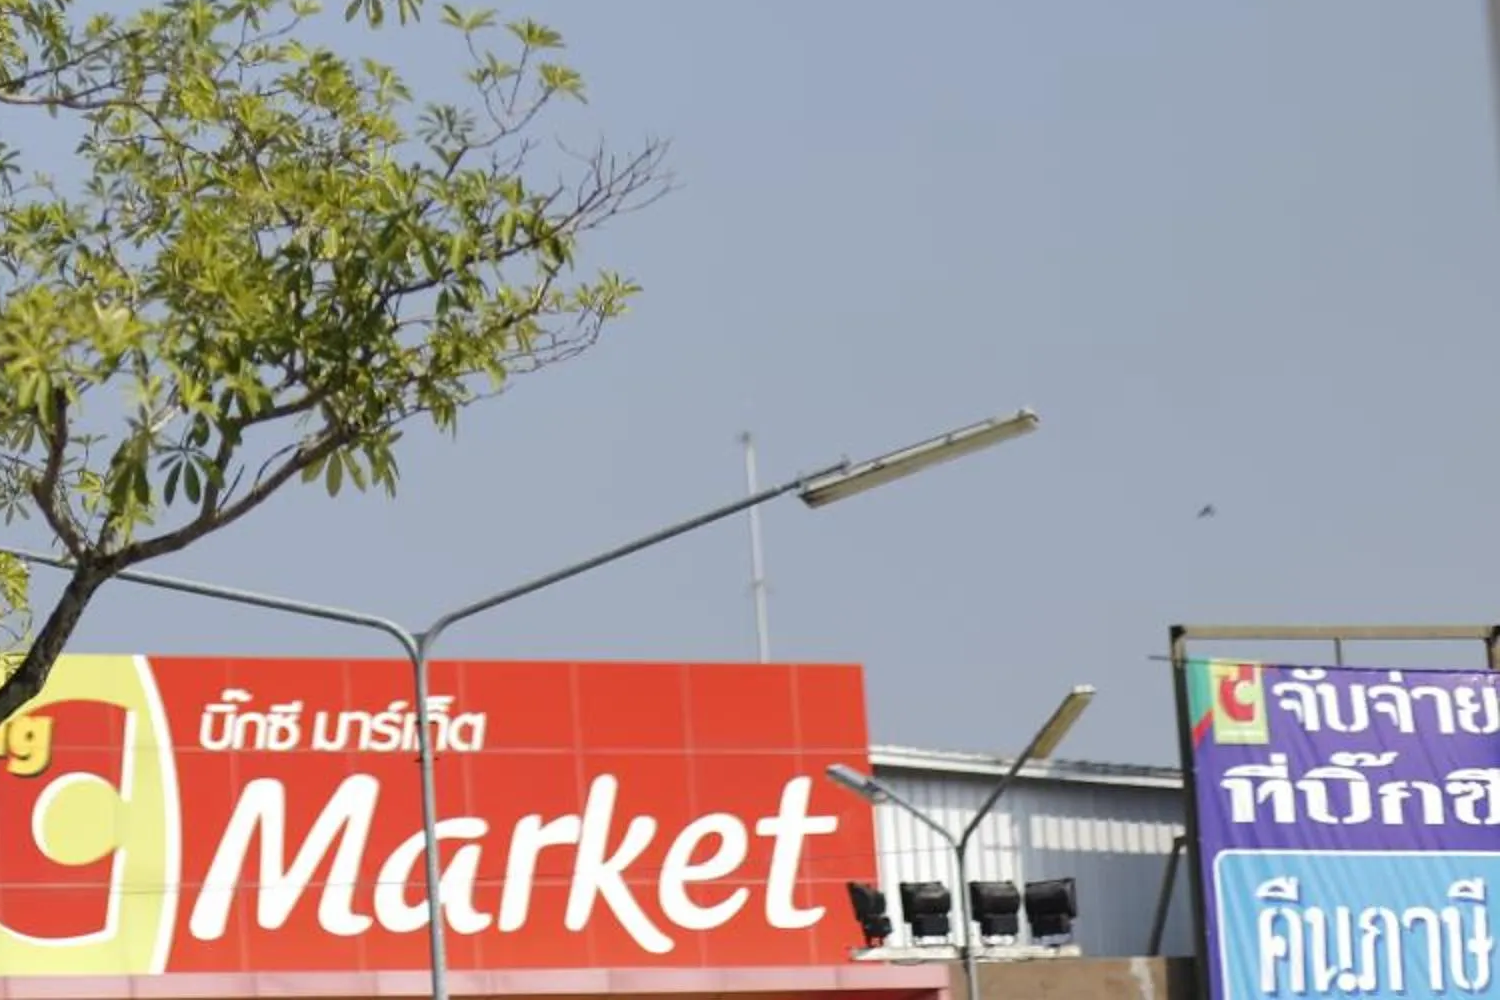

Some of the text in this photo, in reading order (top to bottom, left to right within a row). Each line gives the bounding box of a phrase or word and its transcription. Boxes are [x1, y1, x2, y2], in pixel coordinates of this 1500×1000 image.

[199, 688, 304, 753] บิ๊กซี
[1272, 667, 1500, 735] จับจ่าย
[188, 773, 839, 954] Market
[1254, 875, 1494, 993] คืนภาษี
